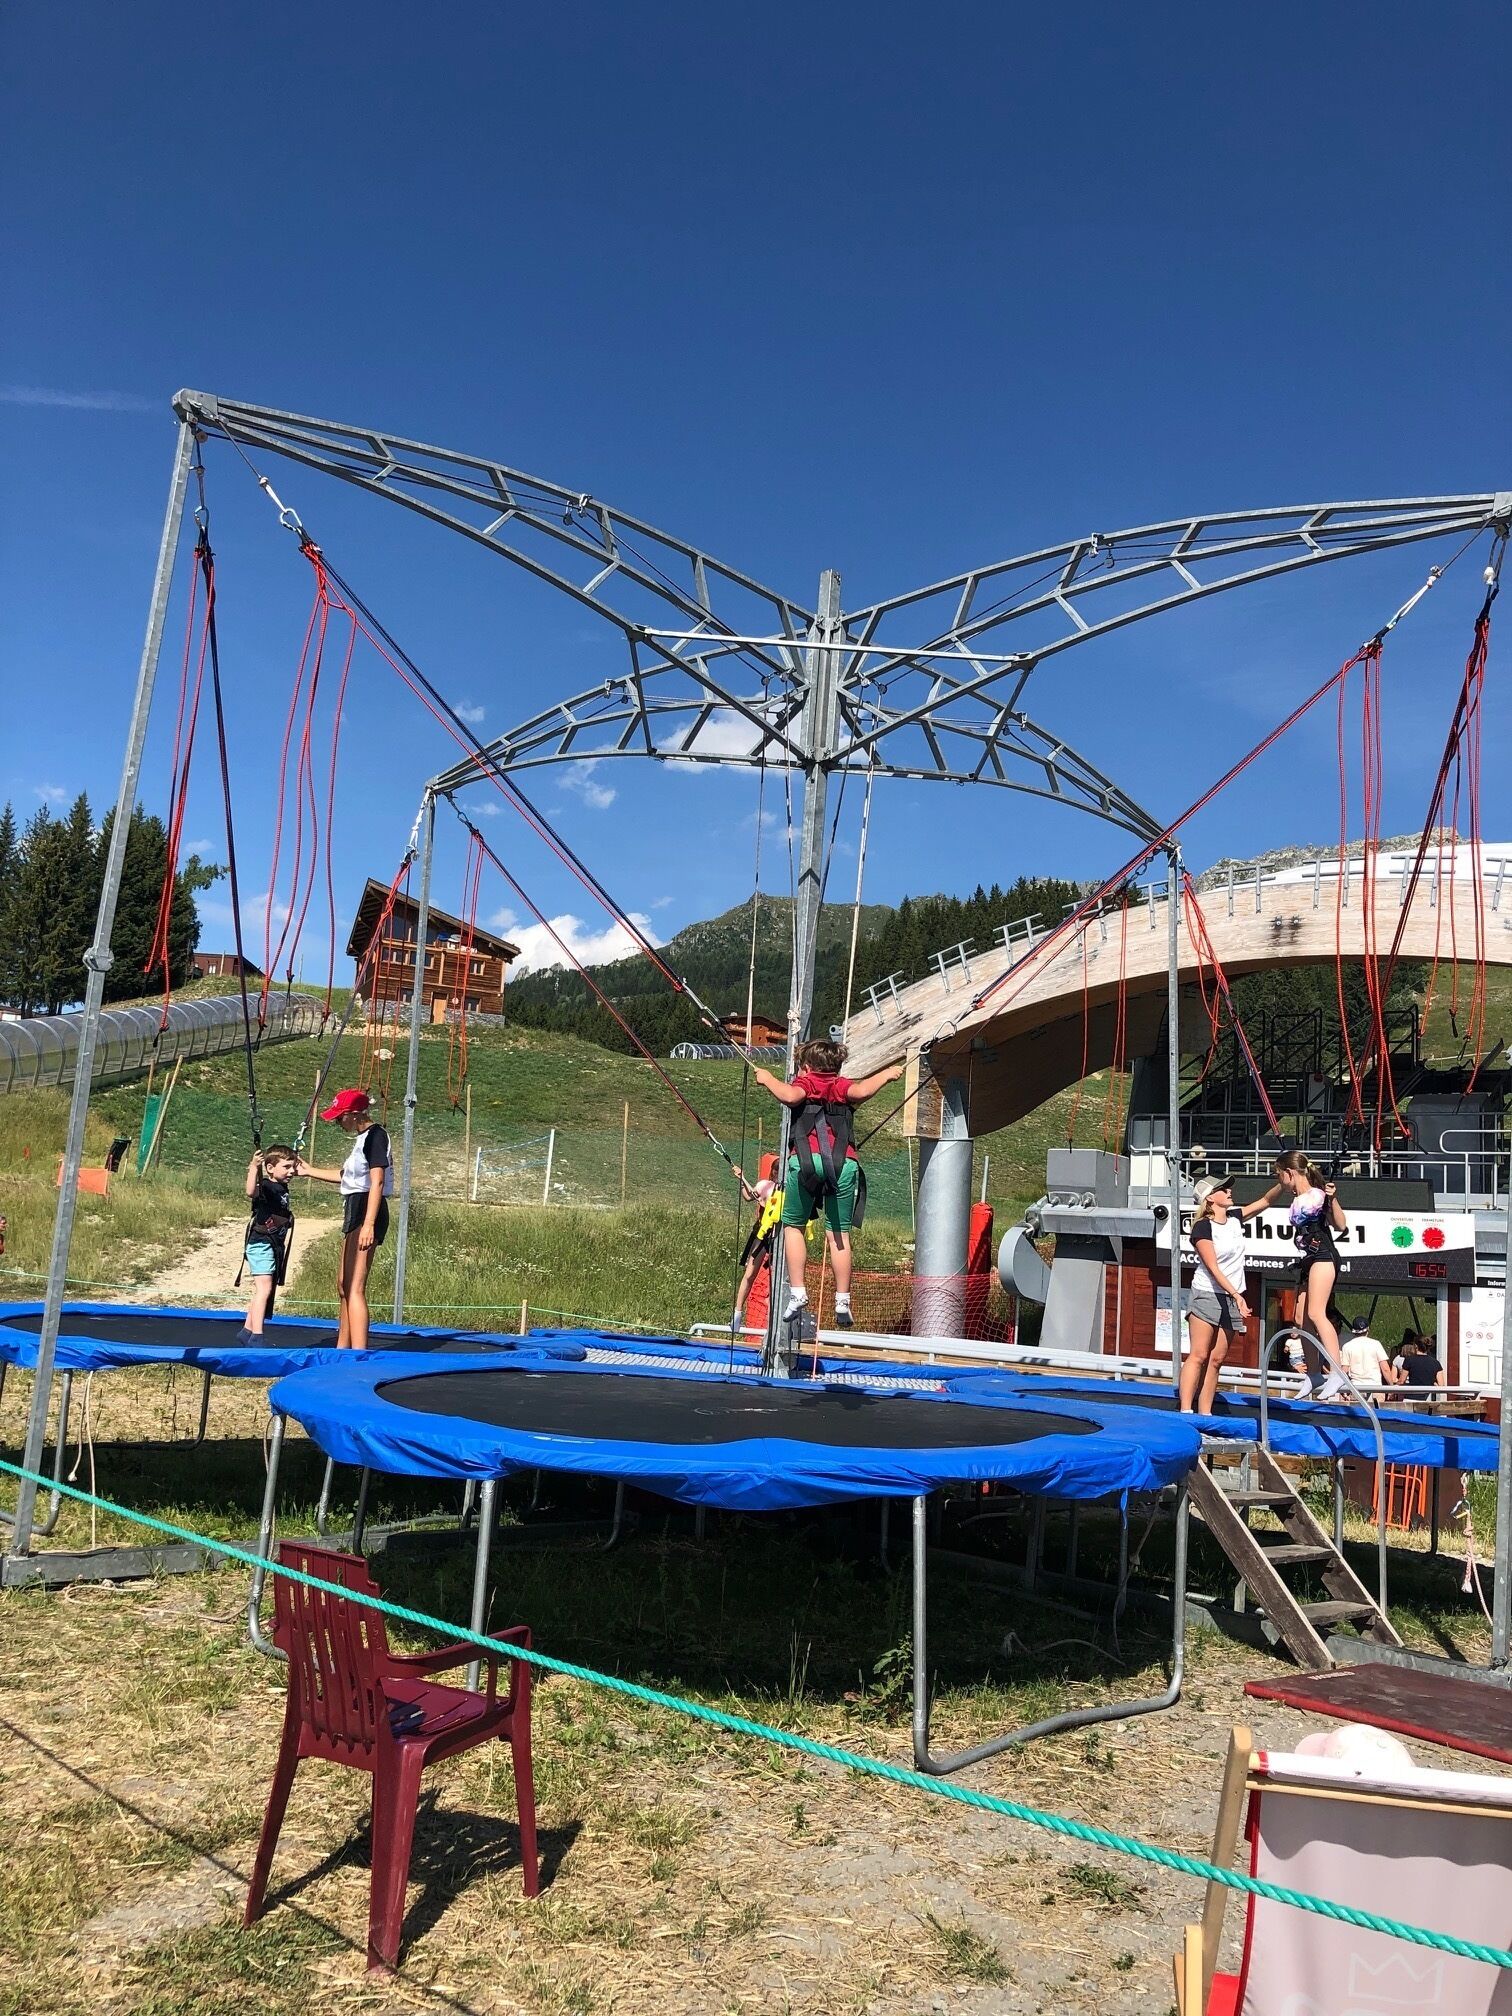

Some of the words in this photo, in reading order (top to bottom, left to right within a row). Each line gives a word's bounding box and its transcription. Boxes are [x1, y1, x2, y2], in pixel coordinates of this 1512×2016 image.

[1241, 1216, 1294, 1240] ahu
[1180, 1253, 1200, 1264] ACC
[1243, 1256, 1285, 1269] idences
